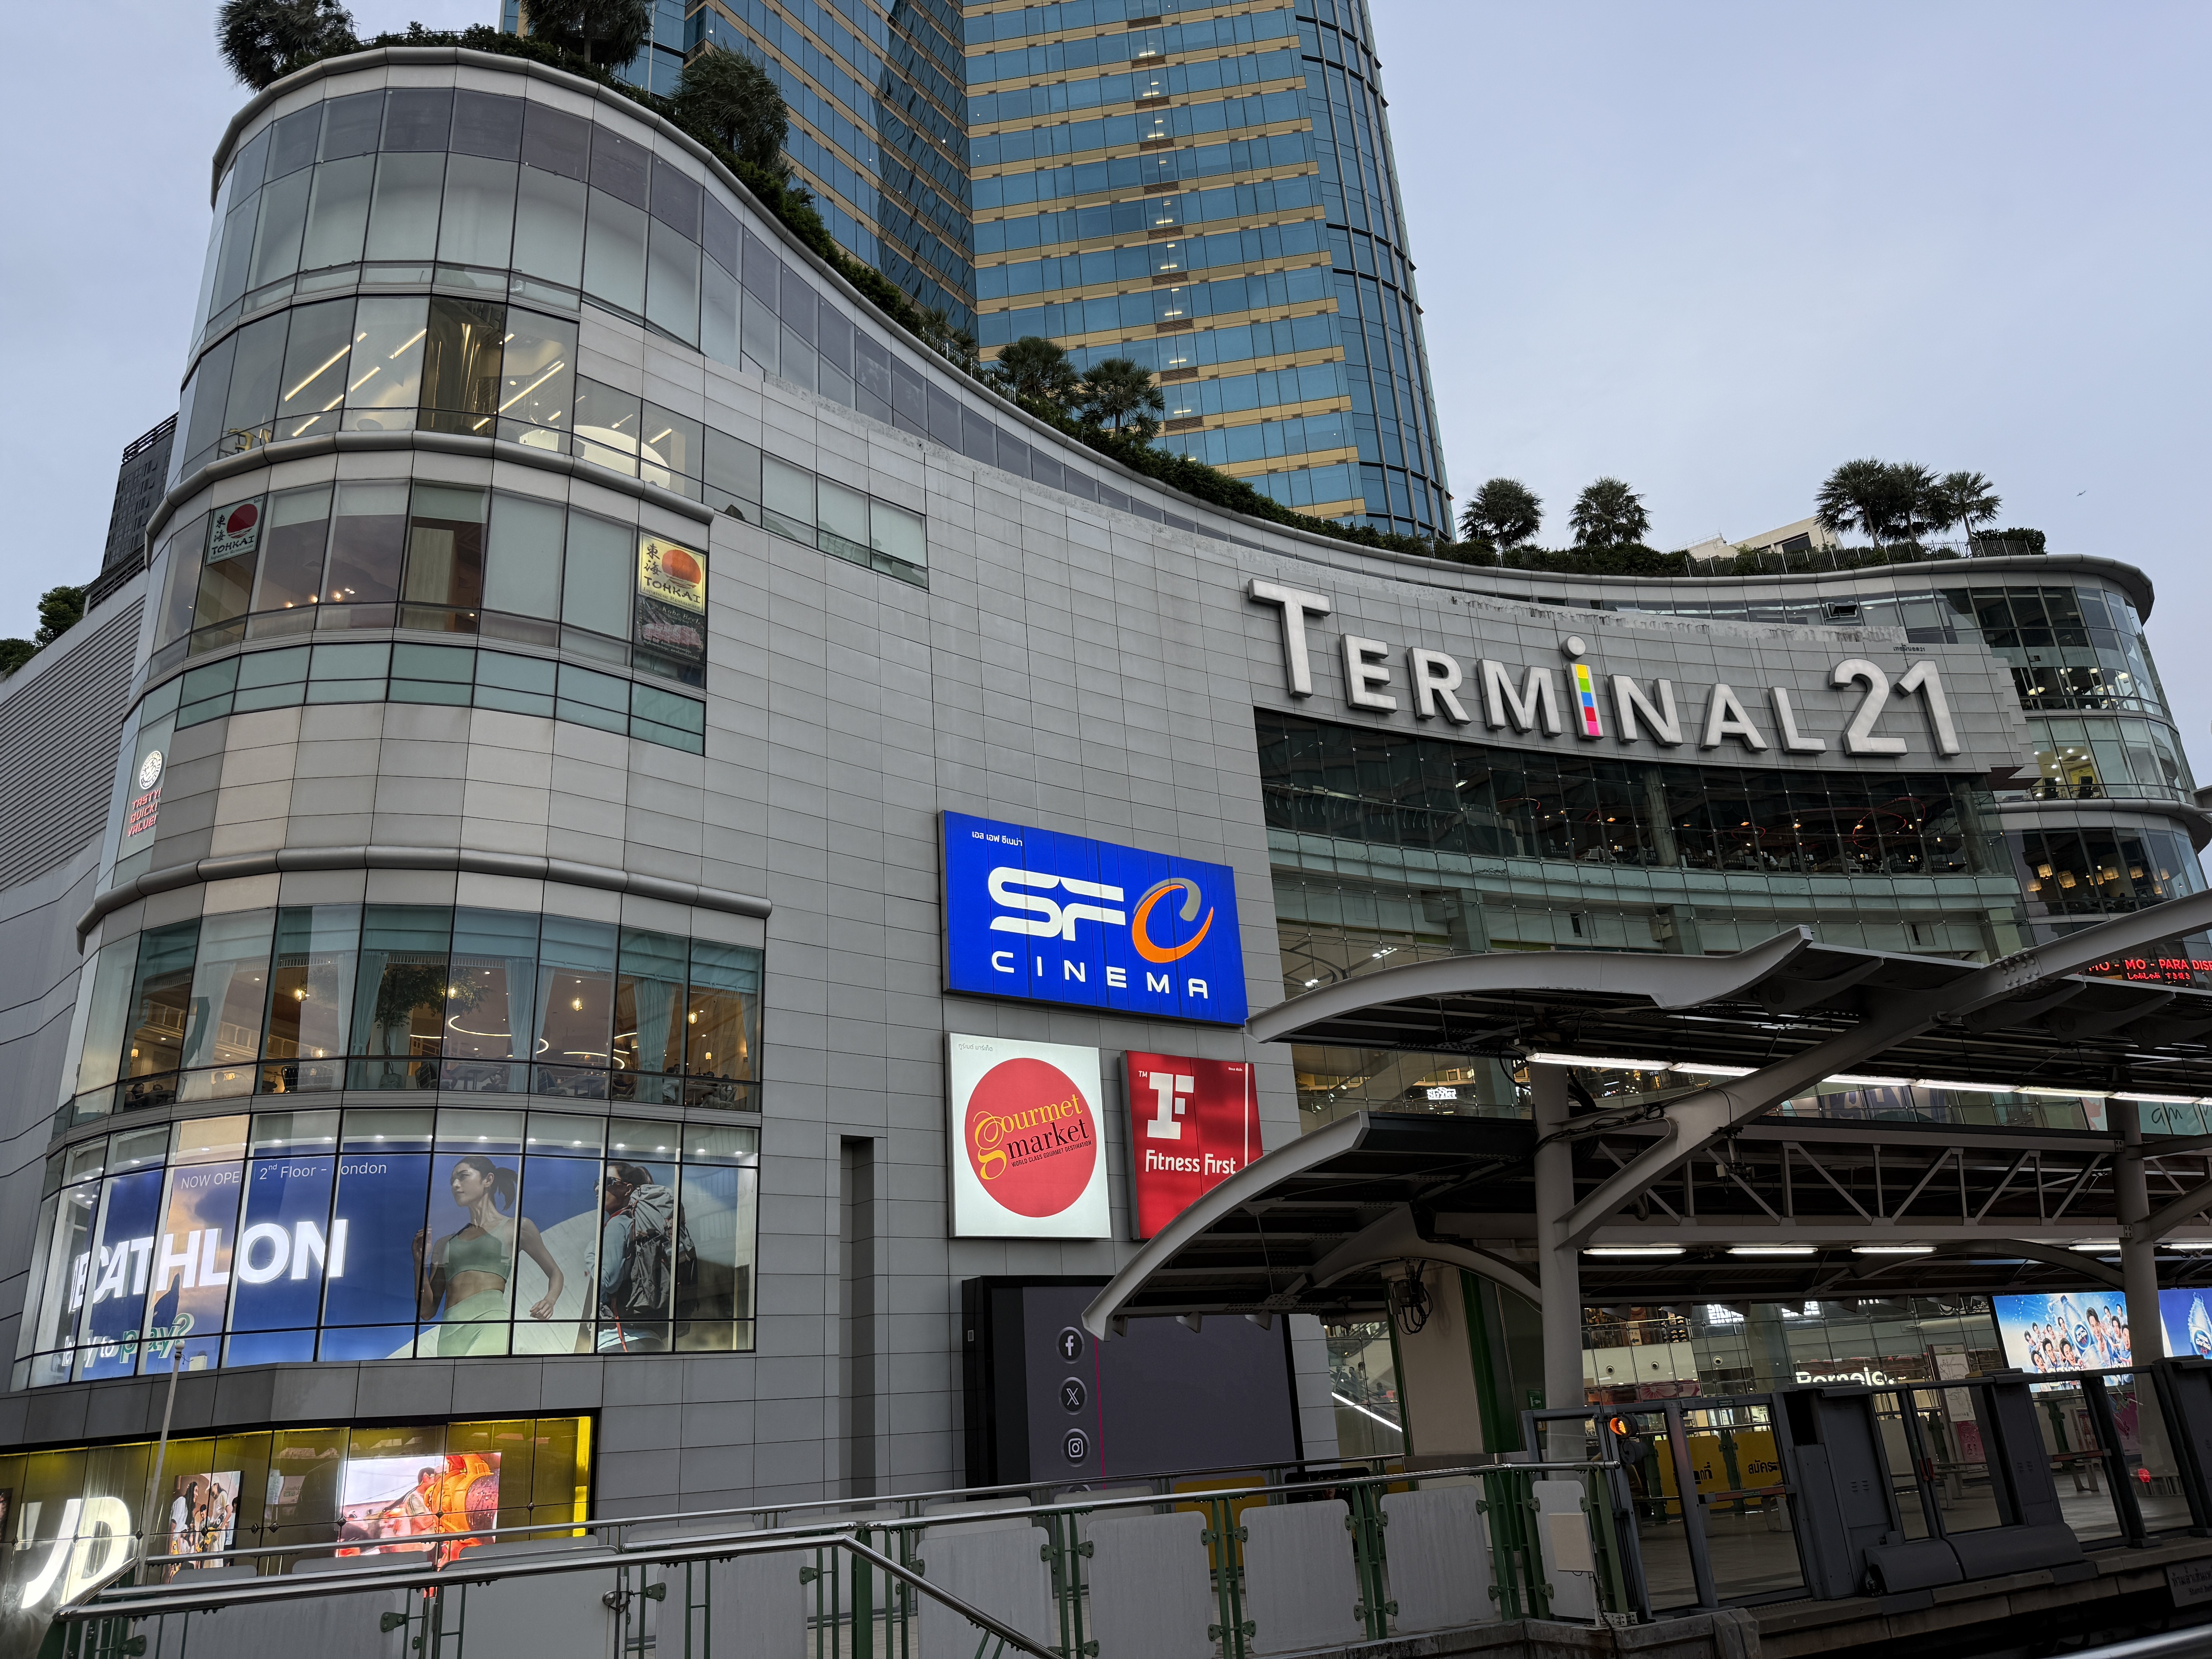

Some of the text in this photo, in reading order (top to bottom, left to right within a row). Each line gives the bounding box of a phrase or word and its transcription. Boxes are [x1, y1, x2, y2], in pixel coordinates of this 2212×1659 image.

[211, 544, 254, 560] Japanese Restaurant
[212, 535, 255, 555] TOHKAI
[644, 543, 662, 576] 東海
[643, 587, 700, 610] Japanese Restaurant
[644, 575, 701, 604] TOHKAI
[662, 606, 681, 617] Kobe
[1829, 658, 1961, 757] 21
[132, 787, 162, 810] TASTY!
[130, 802, 158, 824] QUICK!
[127, 814, 157, 837] VALUE!
[972, 831, 1023, 847] เอส เอฟ ซีเนม่า
[991, 951, 1209, 999] CINEMA
[2124, 959, 2147, 970] MO
[2158, 958, 2190, 970] PARA
[973, 1094, 1083, 1180] gourmet
[1006, 1118, 1089, 1159] market
[1012, 1140, 1092, 1167] WORLD CLASS GOURMET DESTINATION
[1146, 1149, 1237, 1176] Fitness First
[180, 1174, 210, 1189] NOW
[259, 1163, 278, 1180] 2nd
[280, 1166, 316, 1178] Floor
[340, 1162, 387, 1175] ondon
[100, 1336, 120, 1358] to
[120, 1313, 195, 1363] pay?
[21, 1496, 131, 1609] JD
